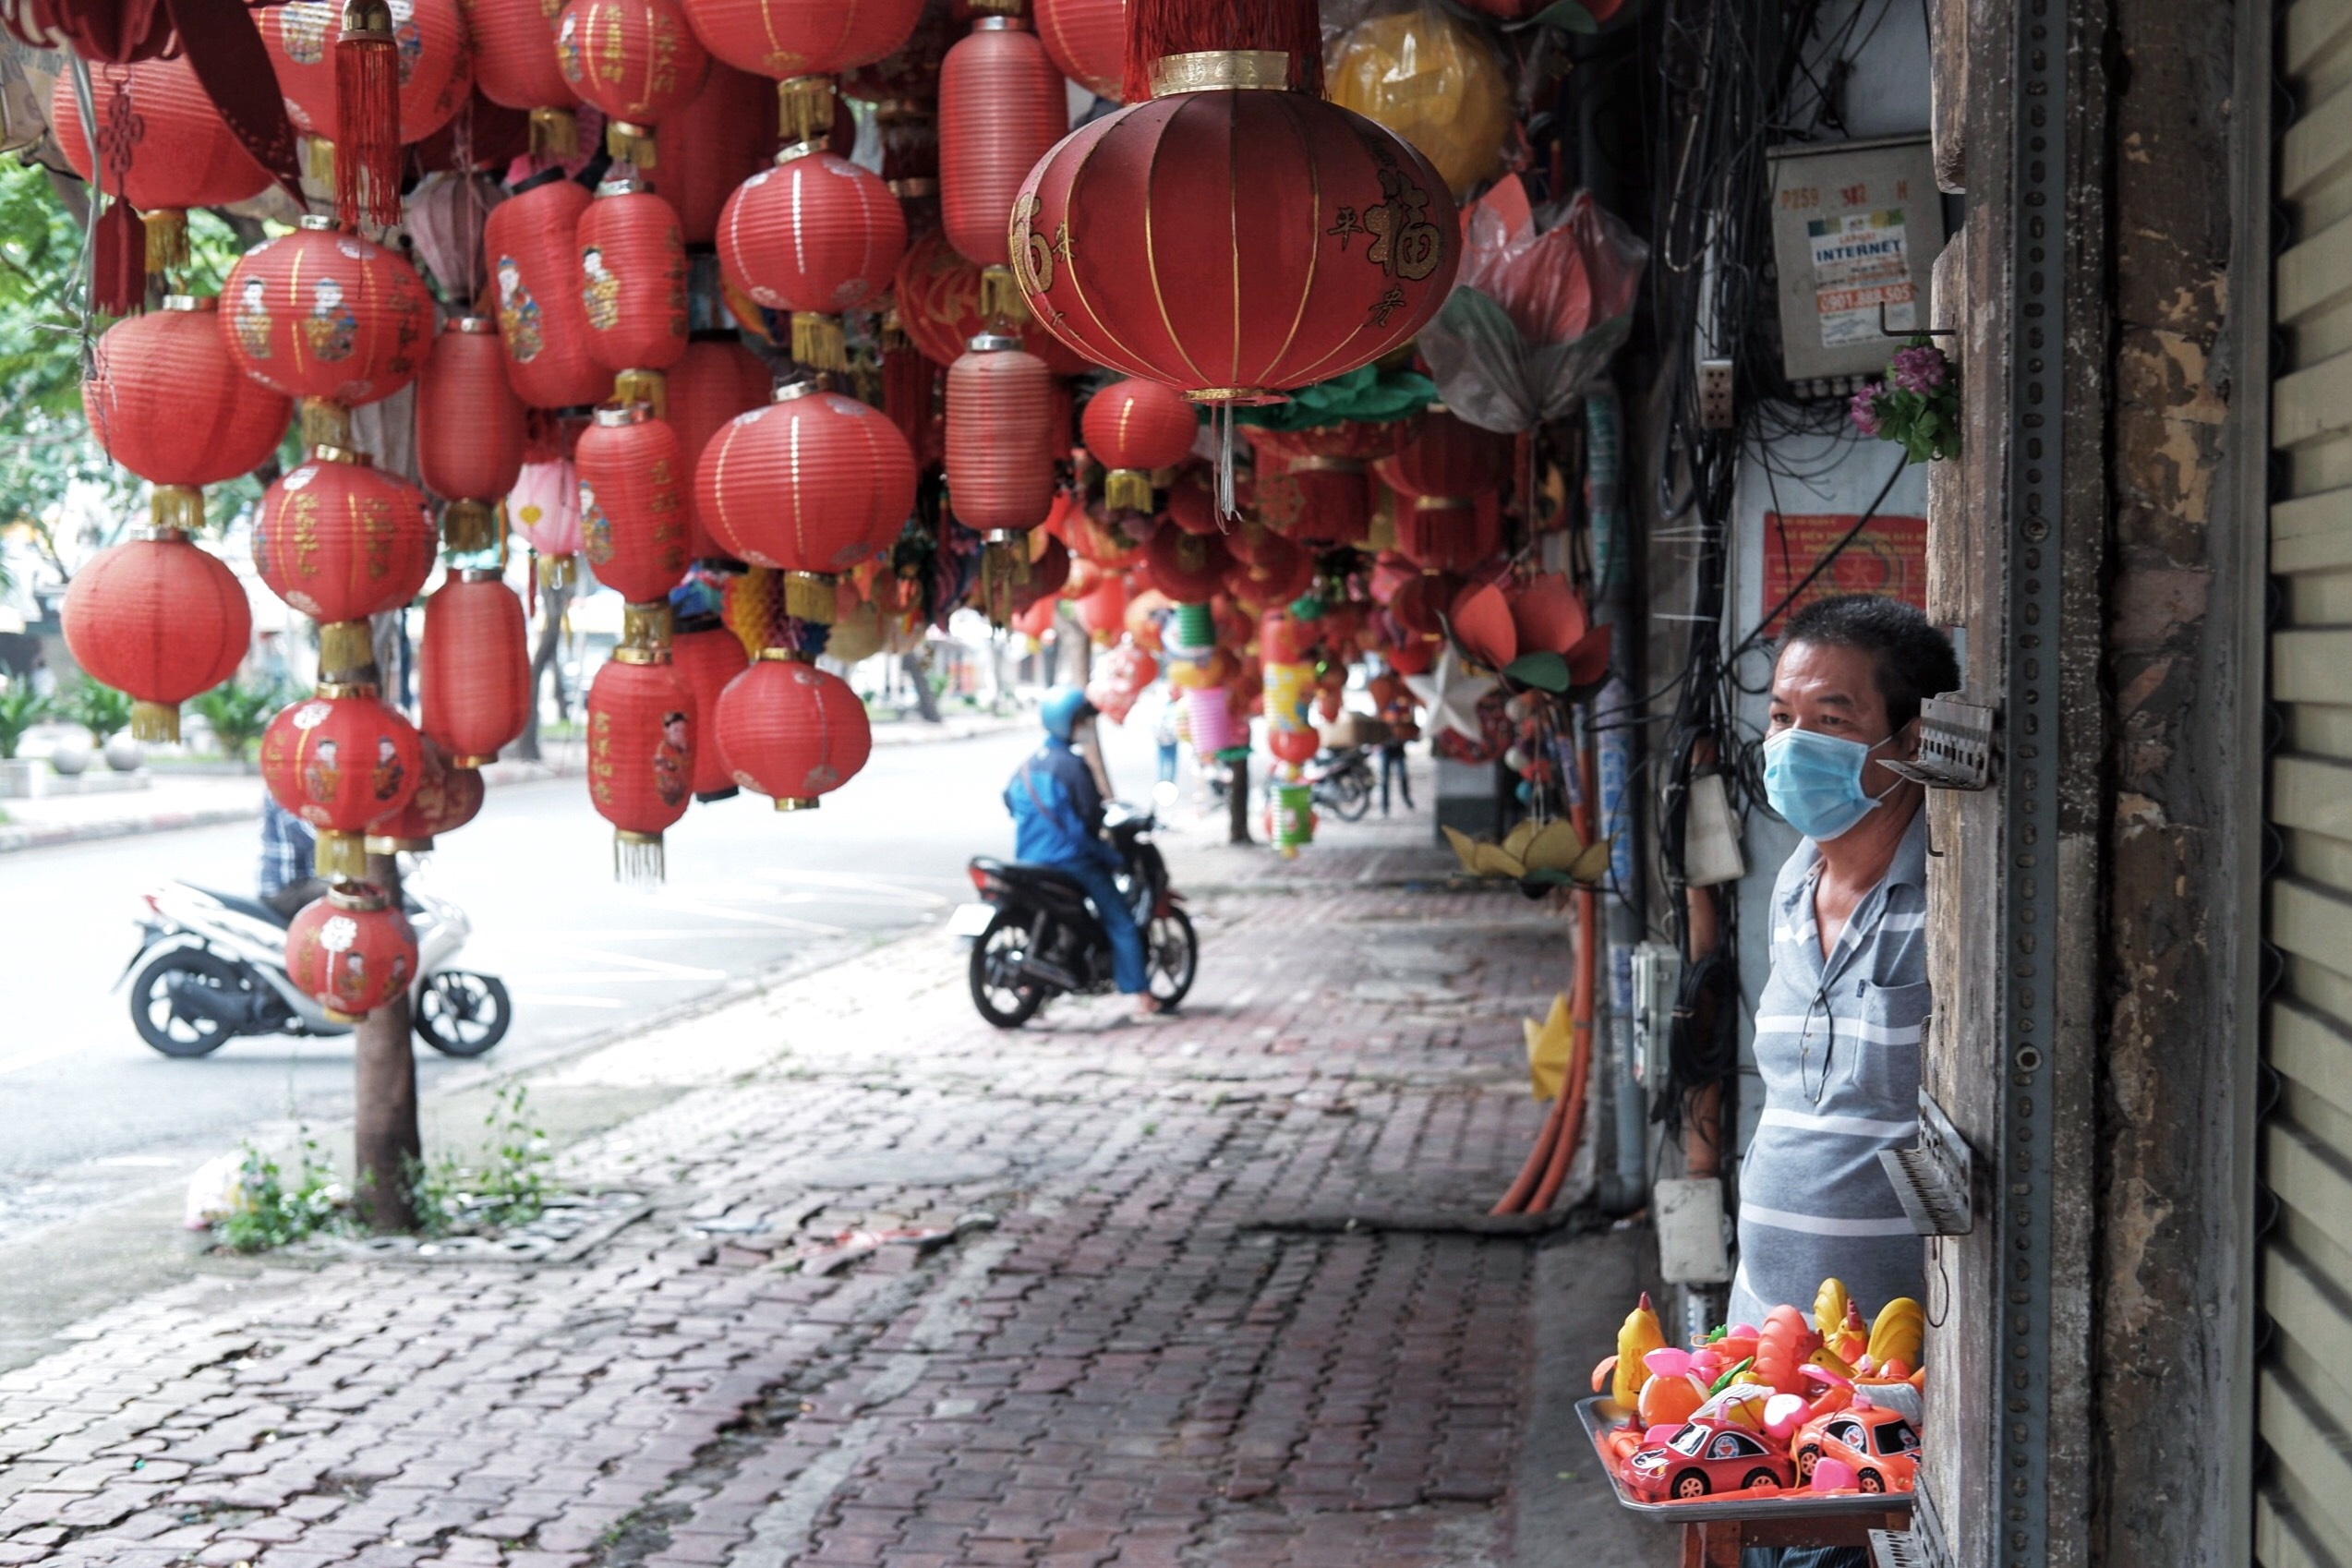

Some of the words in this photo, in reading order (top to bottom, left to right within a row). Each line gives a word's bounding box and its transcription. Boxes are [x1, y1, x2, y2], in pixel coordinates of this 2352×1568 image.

[1327, 206, 1364, 251] 平
[1364, 169, 1441, 281] 福
[1815, 238, 1901, 263] INTERNET
